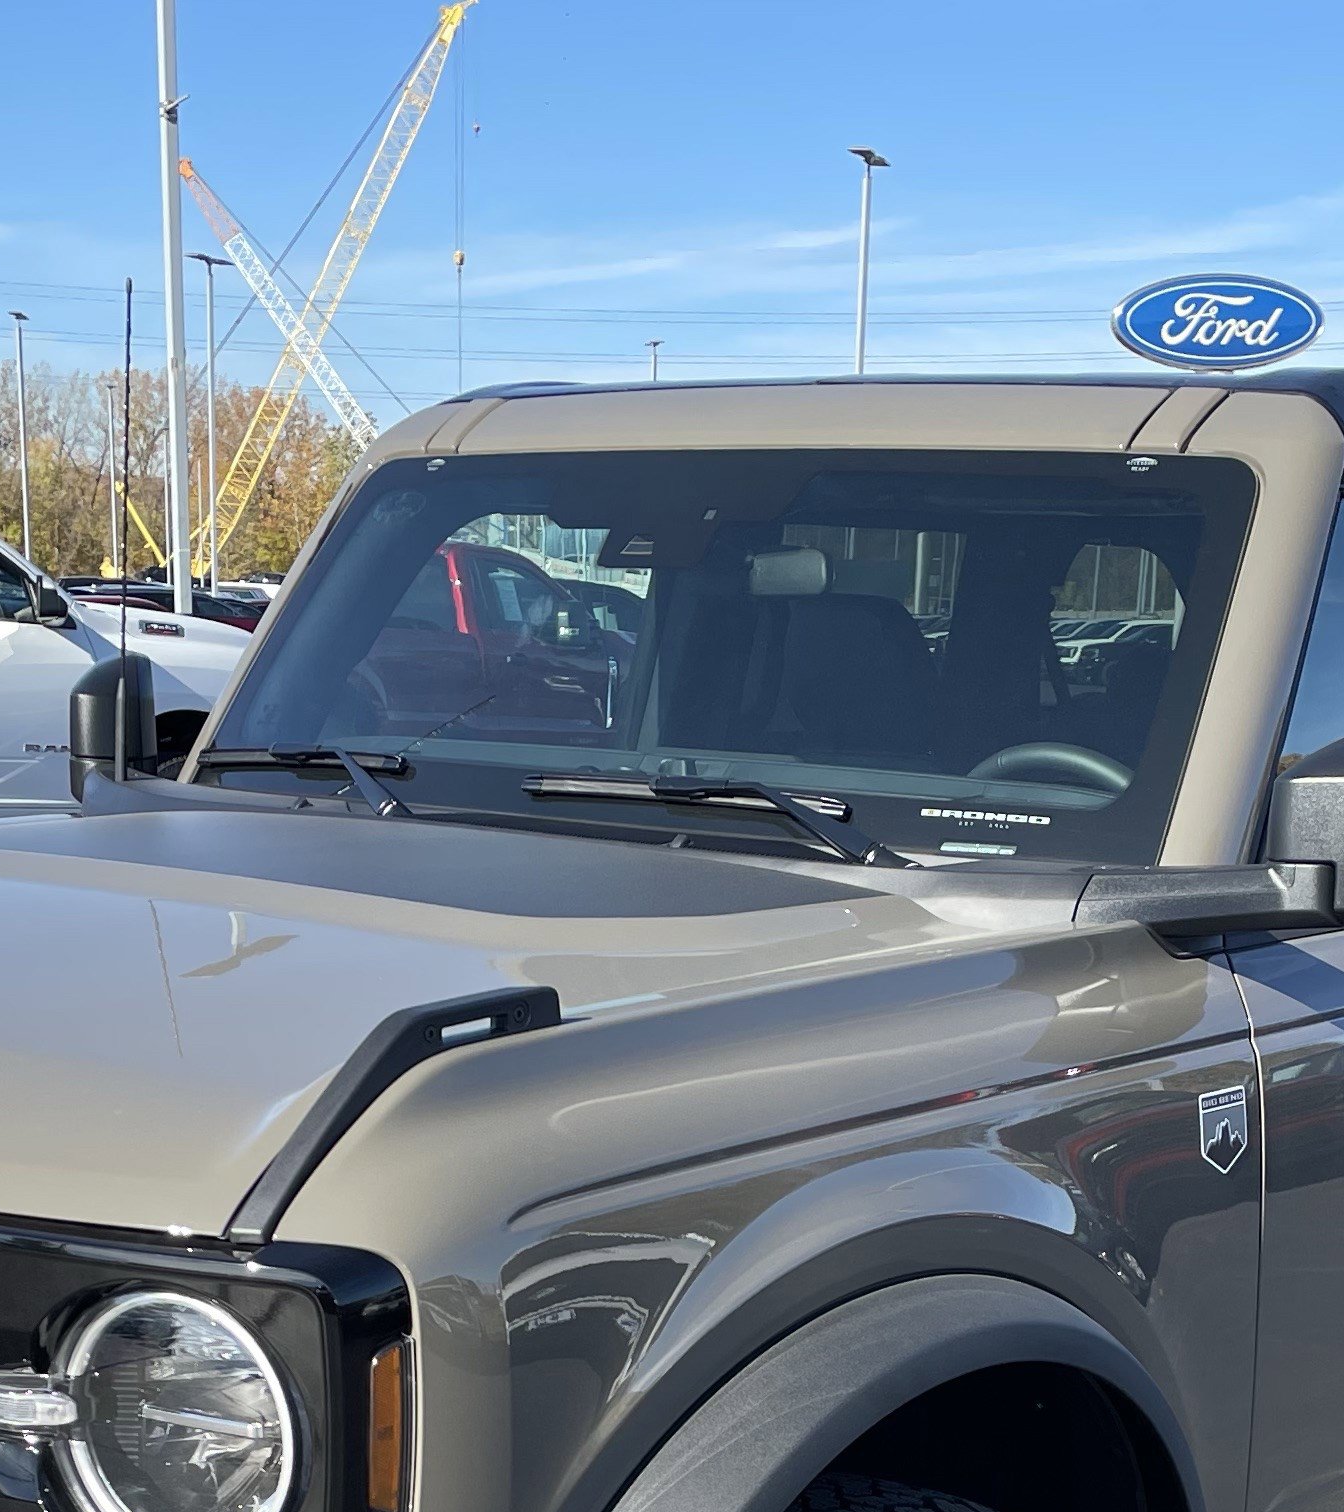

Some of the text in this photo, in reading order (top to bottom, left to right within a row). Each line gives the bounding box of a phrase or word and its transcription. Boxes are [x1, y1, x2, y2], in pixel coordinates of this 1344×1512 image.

[1160, 292, 1283, 346] Ford
[920, 808, 1051, 825] BRONCO
[1218, 1092, 1243, 1104] BEND
